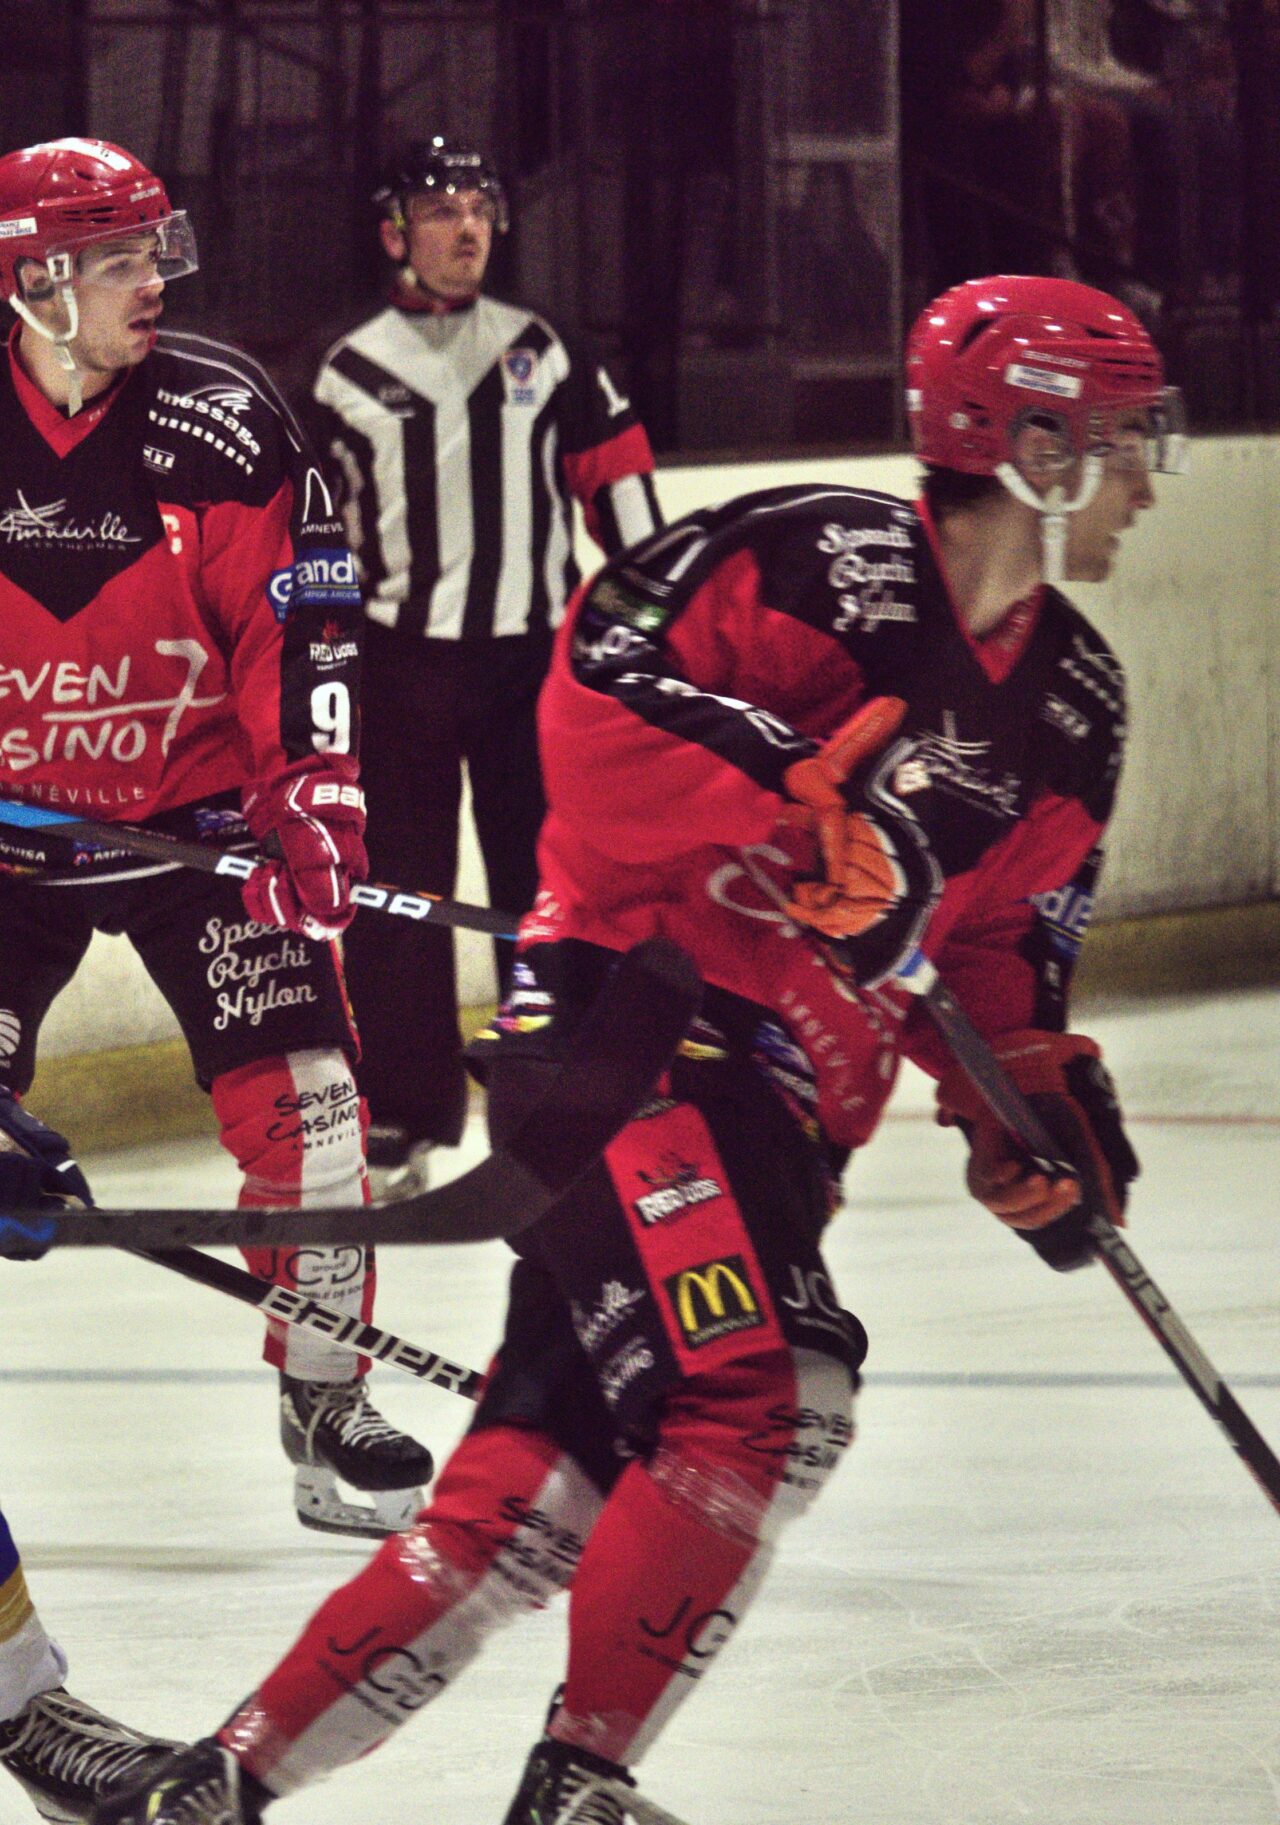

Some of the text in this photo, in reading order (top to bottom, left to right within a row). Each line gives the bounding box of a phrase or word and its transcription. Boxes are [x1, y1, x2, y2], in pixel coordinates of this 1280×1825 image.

[596, 365, 631, 417] 1
[156, 388, 261, 456] message
[311, 681, 351, 755] 9
[206, 939, 312, 989] Rychi
[213, 979, 318, 1031] Nylon
[266, 1102, 359, 1142] CASINO
[273, 1079, 353, 1117] SEVEN
[258, 1285, 472, 1394] BAUER
